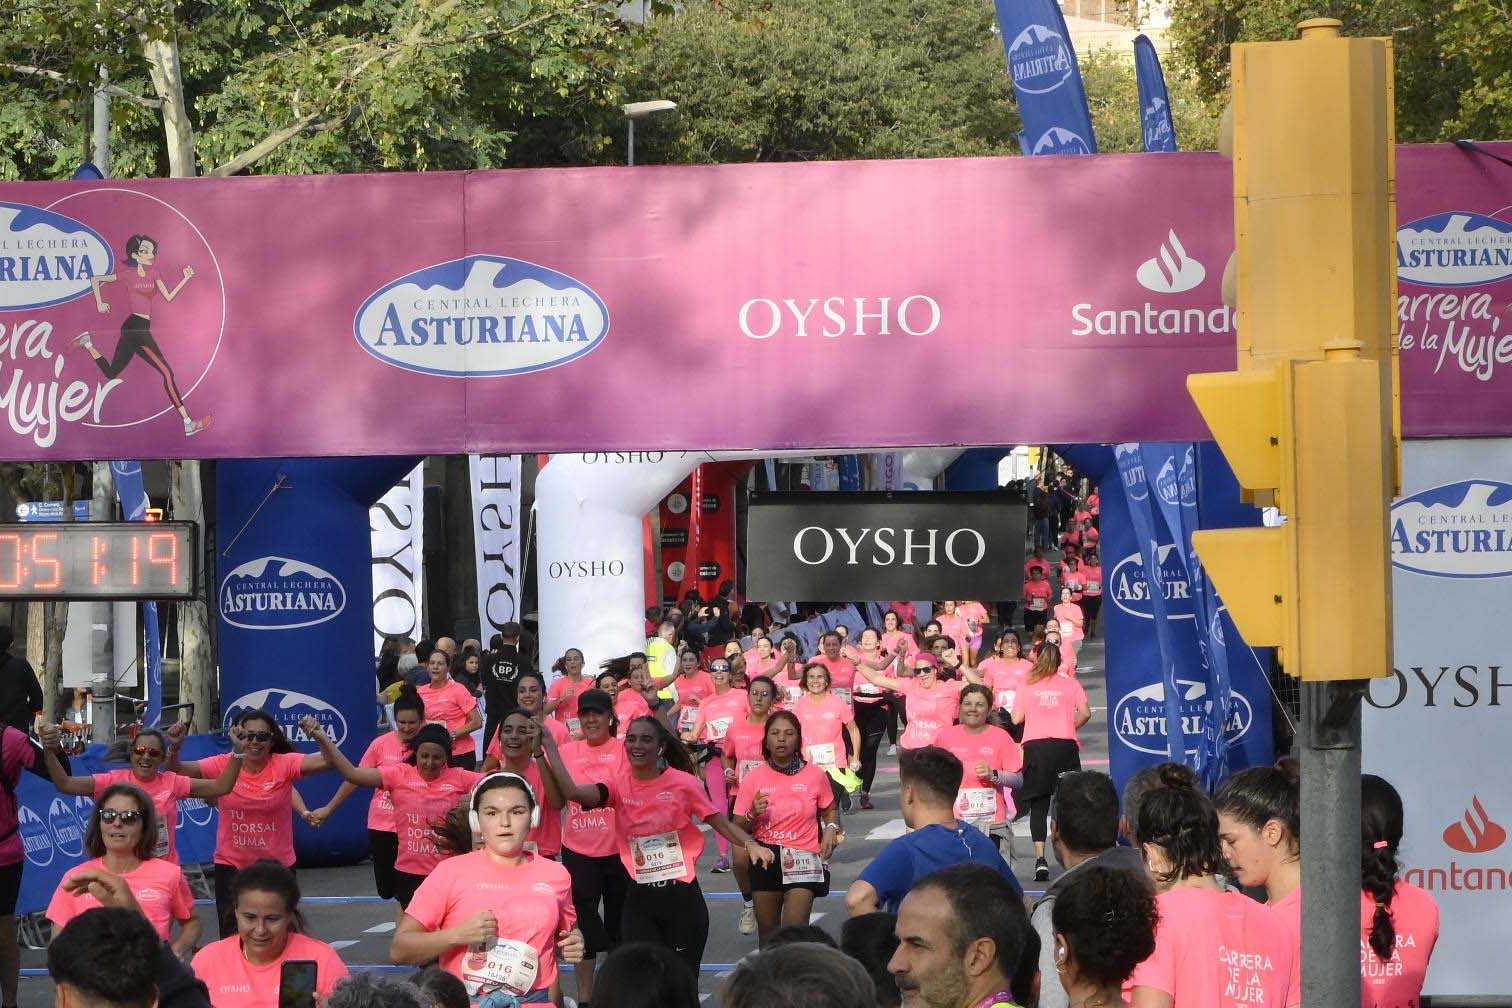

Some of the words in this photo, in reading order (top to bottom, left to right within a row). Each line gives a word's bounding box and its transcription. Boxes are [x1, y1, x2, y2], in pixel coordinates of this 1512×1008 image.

[17, 238, 89, 249] LECHERA
[1397, 241, 1512, 267] STURIAN
[413, 298, 488, 310] CENTRAL
[499, 295, 581, 308] LECHERA
[738, 295, 941, 338] OYSHO
[374, 302, 590, 346] ASTURIANA
[1421, 323, 1438, 349] la
[1418, 514, 1487, 525] CENTRAL
[793, 526, 986, 567] OYSHO
[548, 559, 624, 579] OYSHO
[236, 581, 281, 591] CENTRAL
[284, 580, 333, 590] LECHERA
[224, 590, 336, 614] ASTURIANA
[498, 666, 513, 675] BP
[406, 813, 418, 823] TU
[572, 816, 606, 829] SUMA
[232, 822, 276, 833] DORSAL
[233, 835, 266, 846] SUMA
[408, 841, 439, 854] SUMA
[1399, 864, 1512, 891] antan
[487, 961, 513, 974] 016
